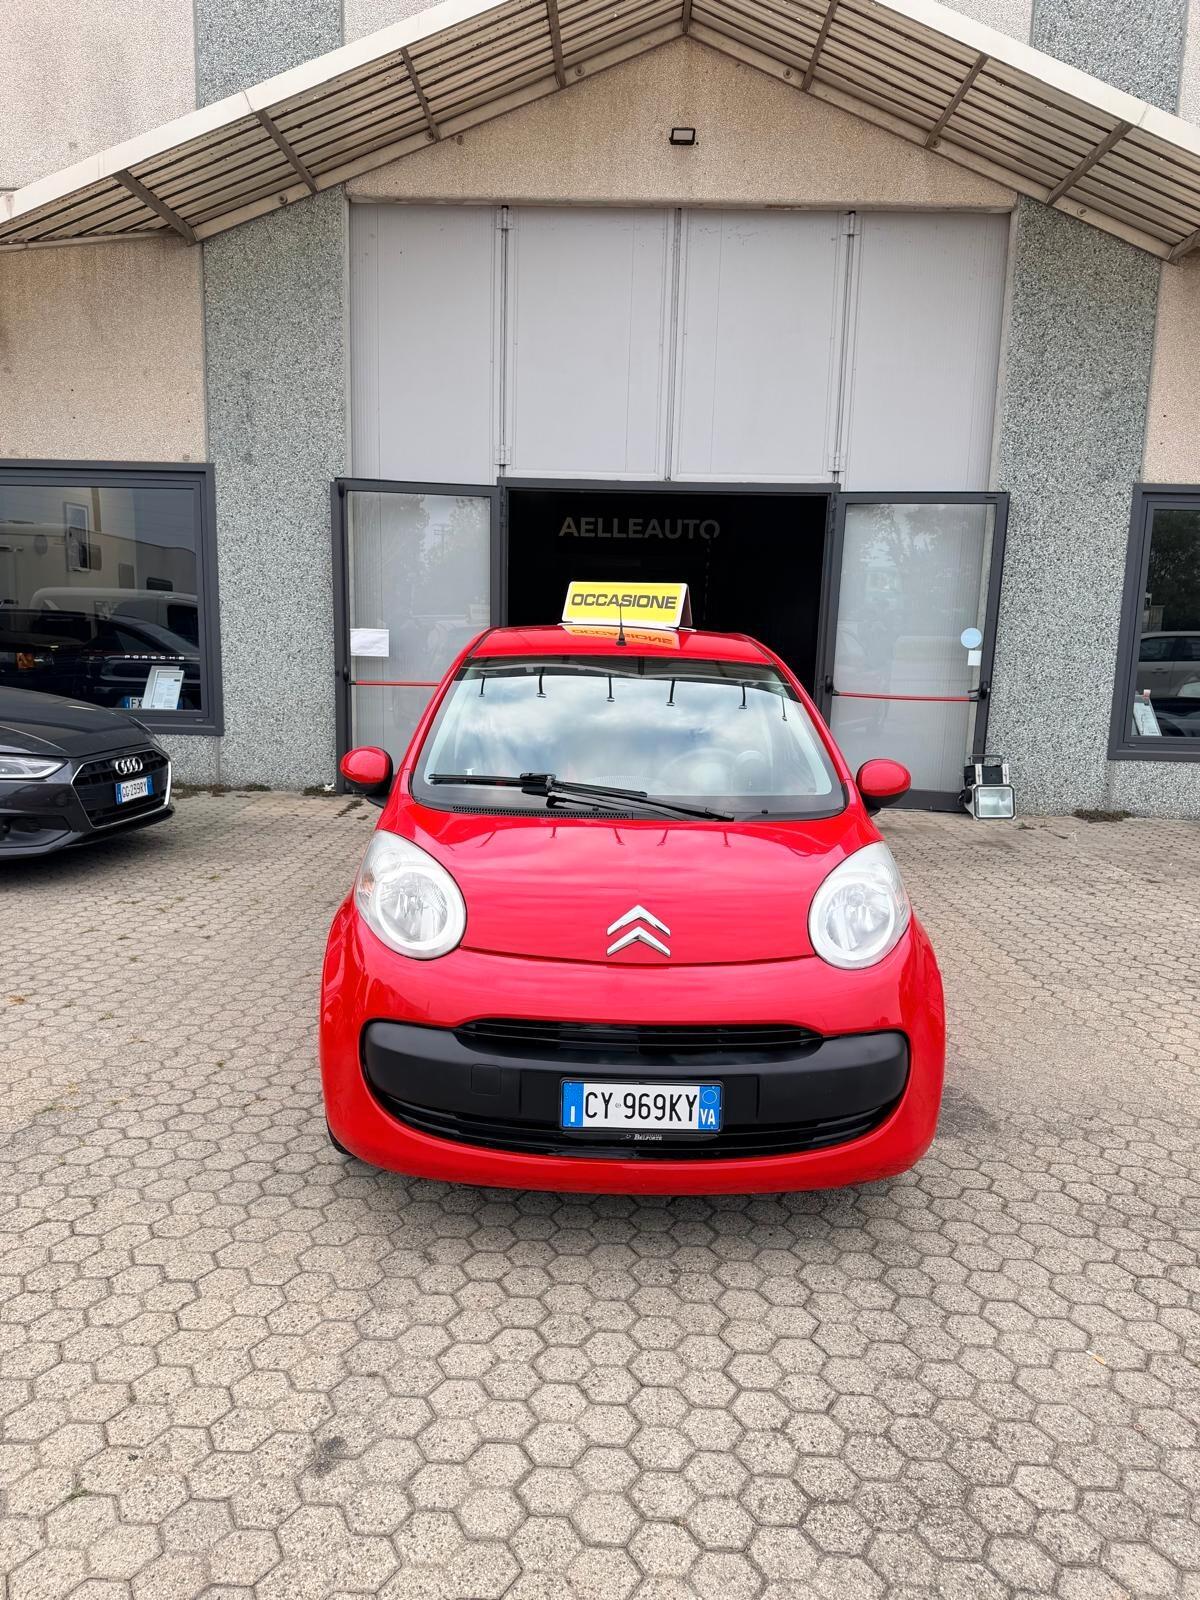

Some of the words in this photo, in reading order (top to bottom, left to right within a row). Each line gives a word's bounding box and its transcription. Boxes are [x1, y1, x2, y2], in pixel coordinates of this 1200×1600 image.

[558, 516, 721, 540] AELLEAUTO
[571, 593, 678, 610] OCCASIONE
[700, 1108, 716, 1126] VA
